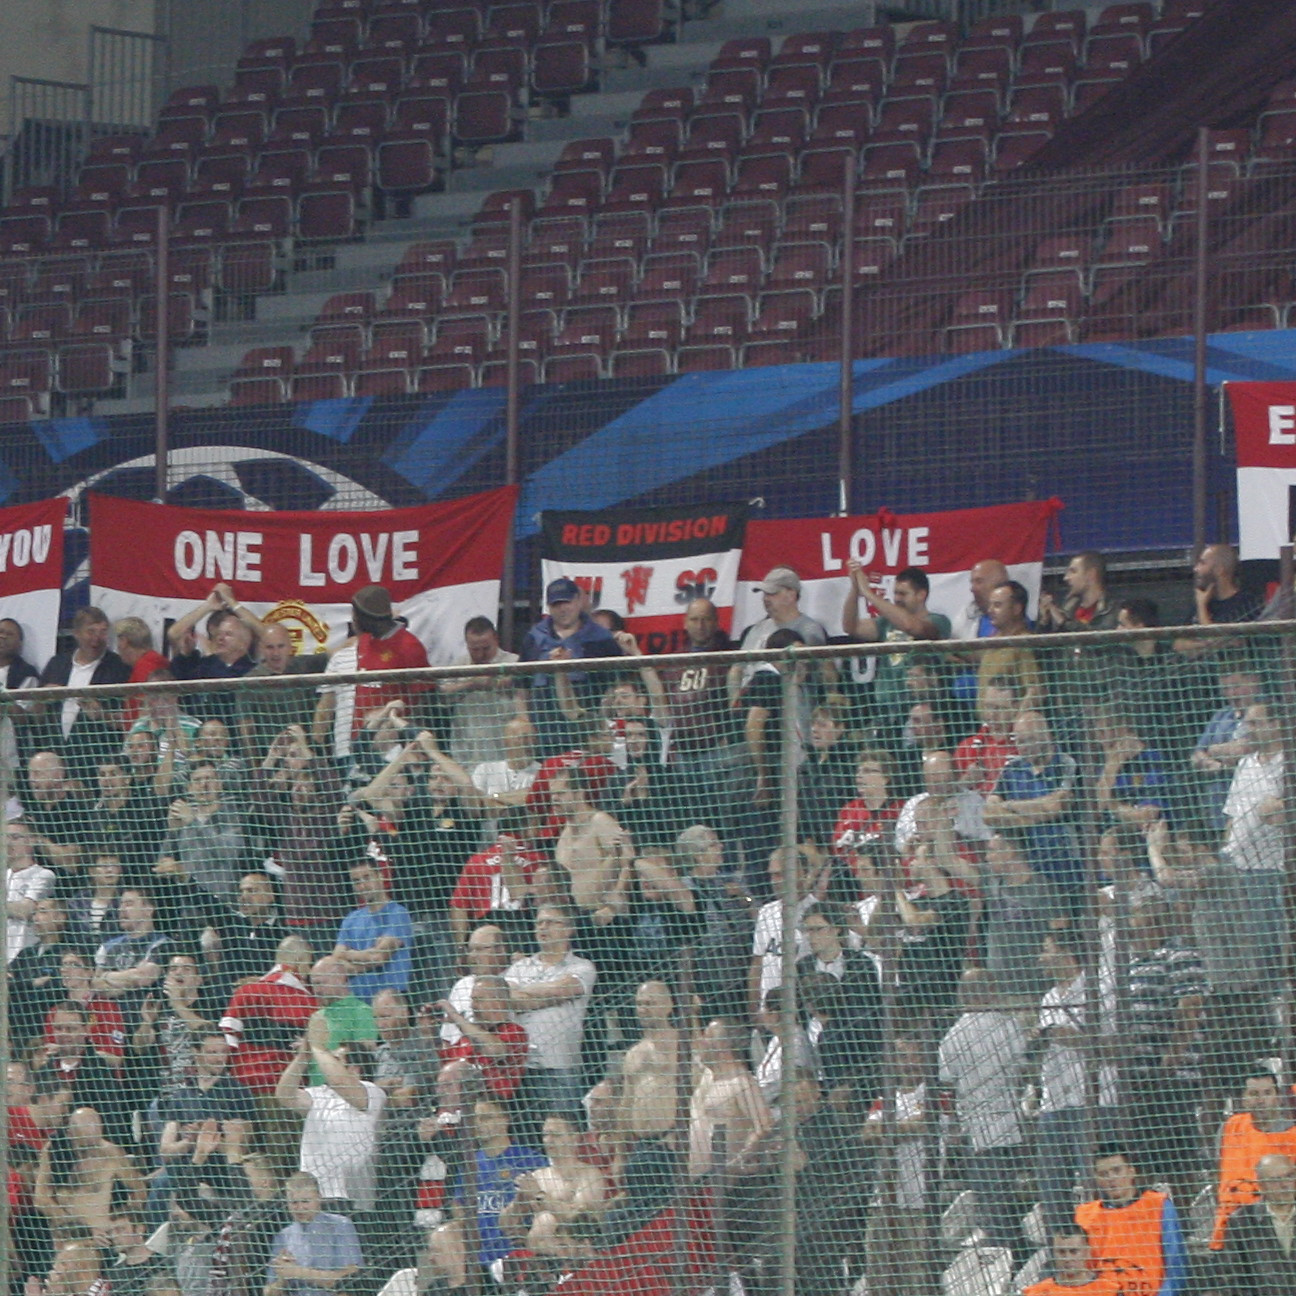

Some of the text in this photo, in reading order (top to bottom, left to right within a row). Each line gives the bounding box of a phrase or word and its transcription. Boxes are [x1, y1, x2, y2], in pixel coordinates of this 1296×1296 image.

[562, 515, 728, 547] RED DIVISION
[821, 527, 930, 572] LOVE
[174, 530, 421, 587] ONE LOVE
